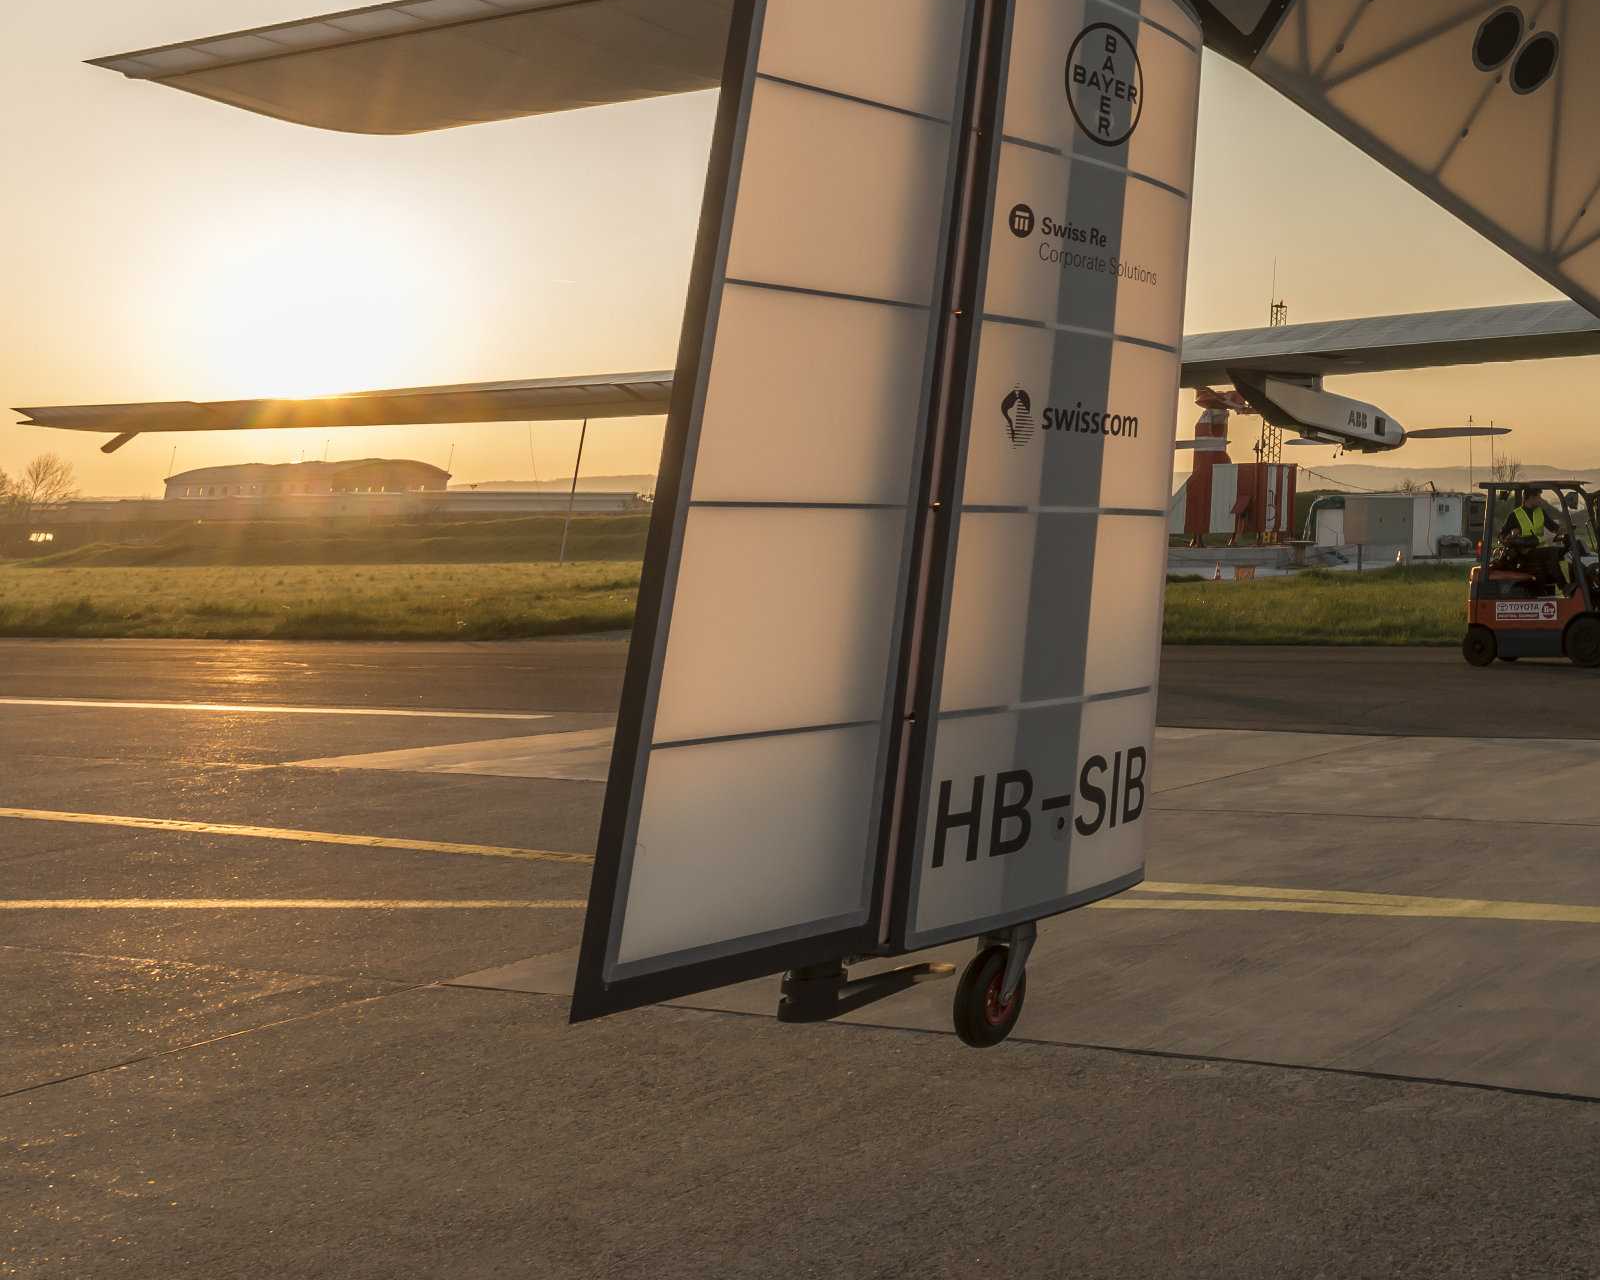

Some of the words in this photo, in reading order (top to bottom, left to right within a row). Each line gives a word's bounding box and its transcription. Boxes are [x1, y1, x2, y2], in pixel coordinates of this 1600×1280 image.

[1072, 63, 1138, 105] BAYER
[1098, 34, 1117, 137] BAYER
[1041, 216, 1087, 243] Swiss
[1089, 228, 1107, 248] Re
[1038, 242, 1106, 274] Corporate
[1109, 256, 1158, 286] Solutions
[1041, 401, 1139, 438] swisscom
[1347, 410, 1368, 430] ABB
[931, 745, 1147, 869] HB-SIB
